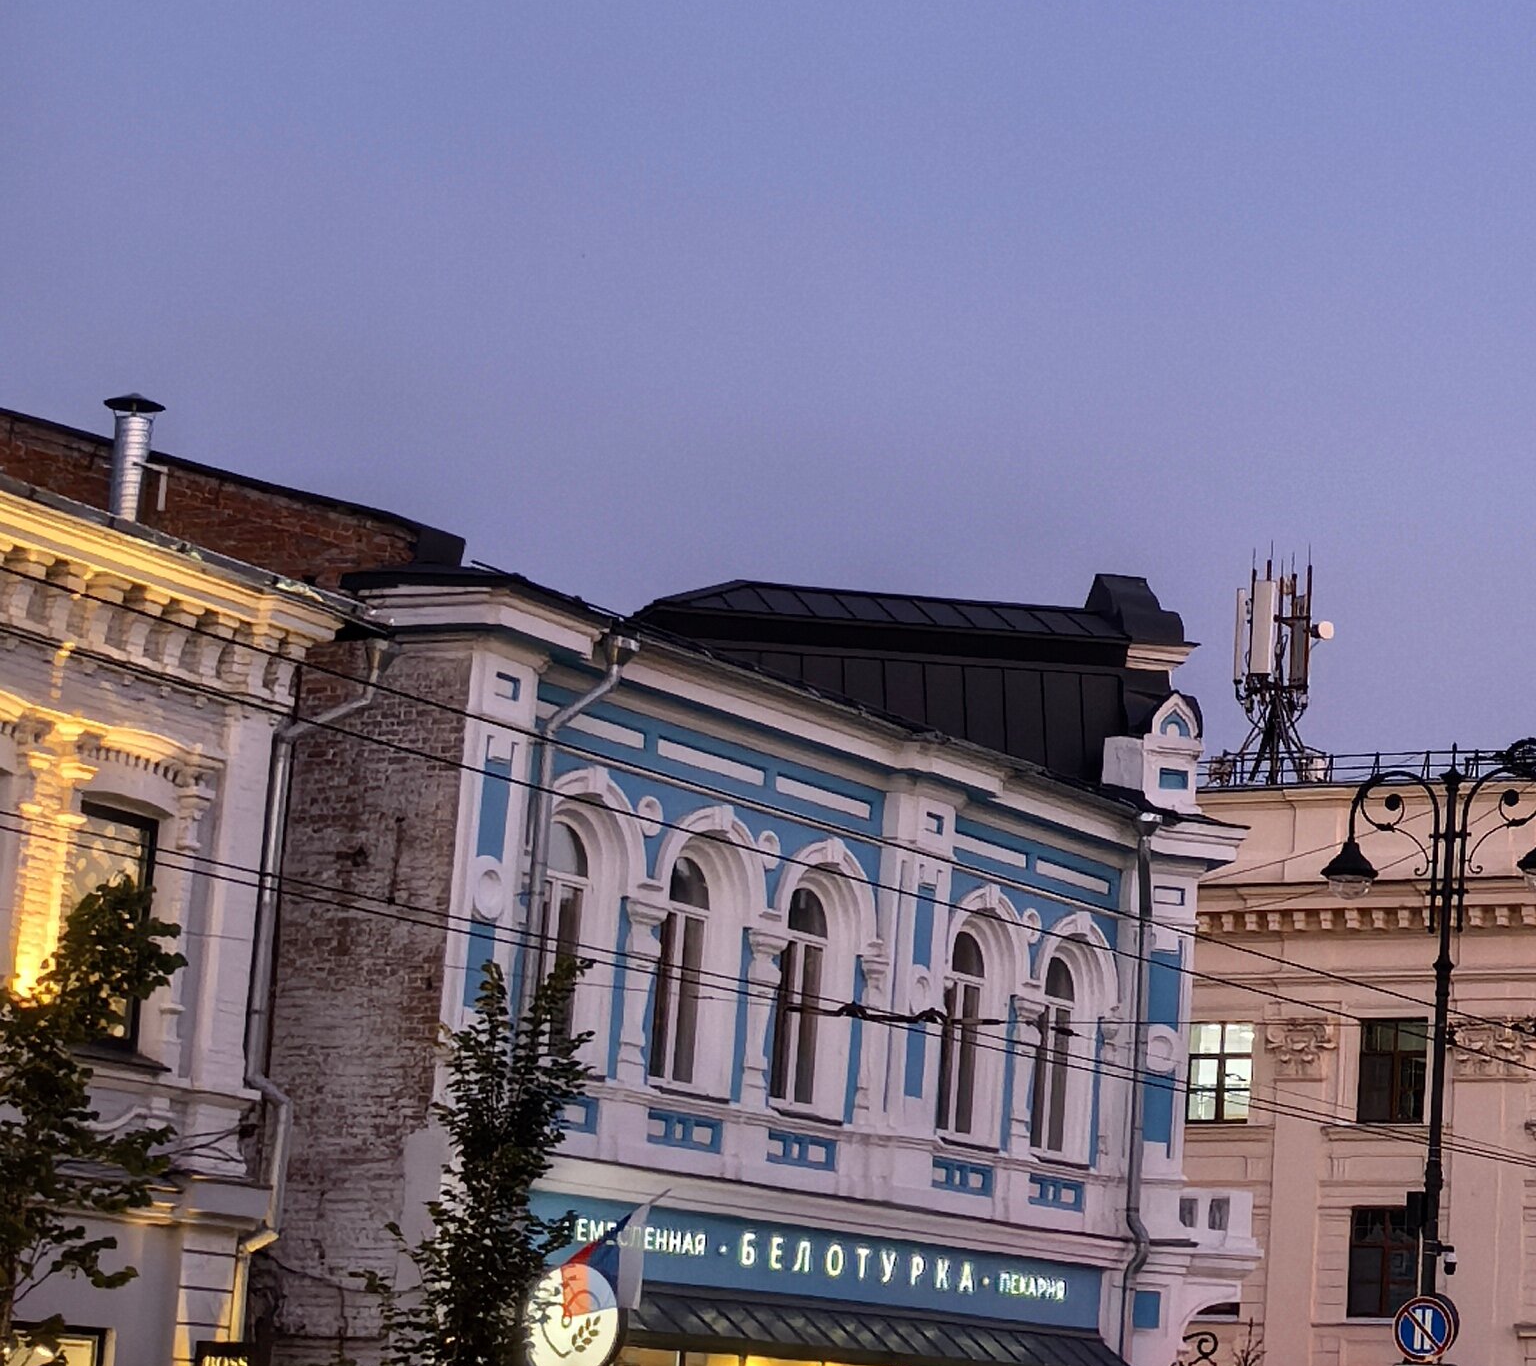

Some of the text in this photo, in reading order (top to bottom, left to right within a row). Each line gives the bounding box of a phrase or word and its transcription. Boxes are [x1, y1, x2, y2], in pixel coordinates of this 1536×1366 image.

[563, 1217, 1066, 1301] ЕМСЛЕННАЯ БЕЛОТУРКА ПЕКАРНЯ
